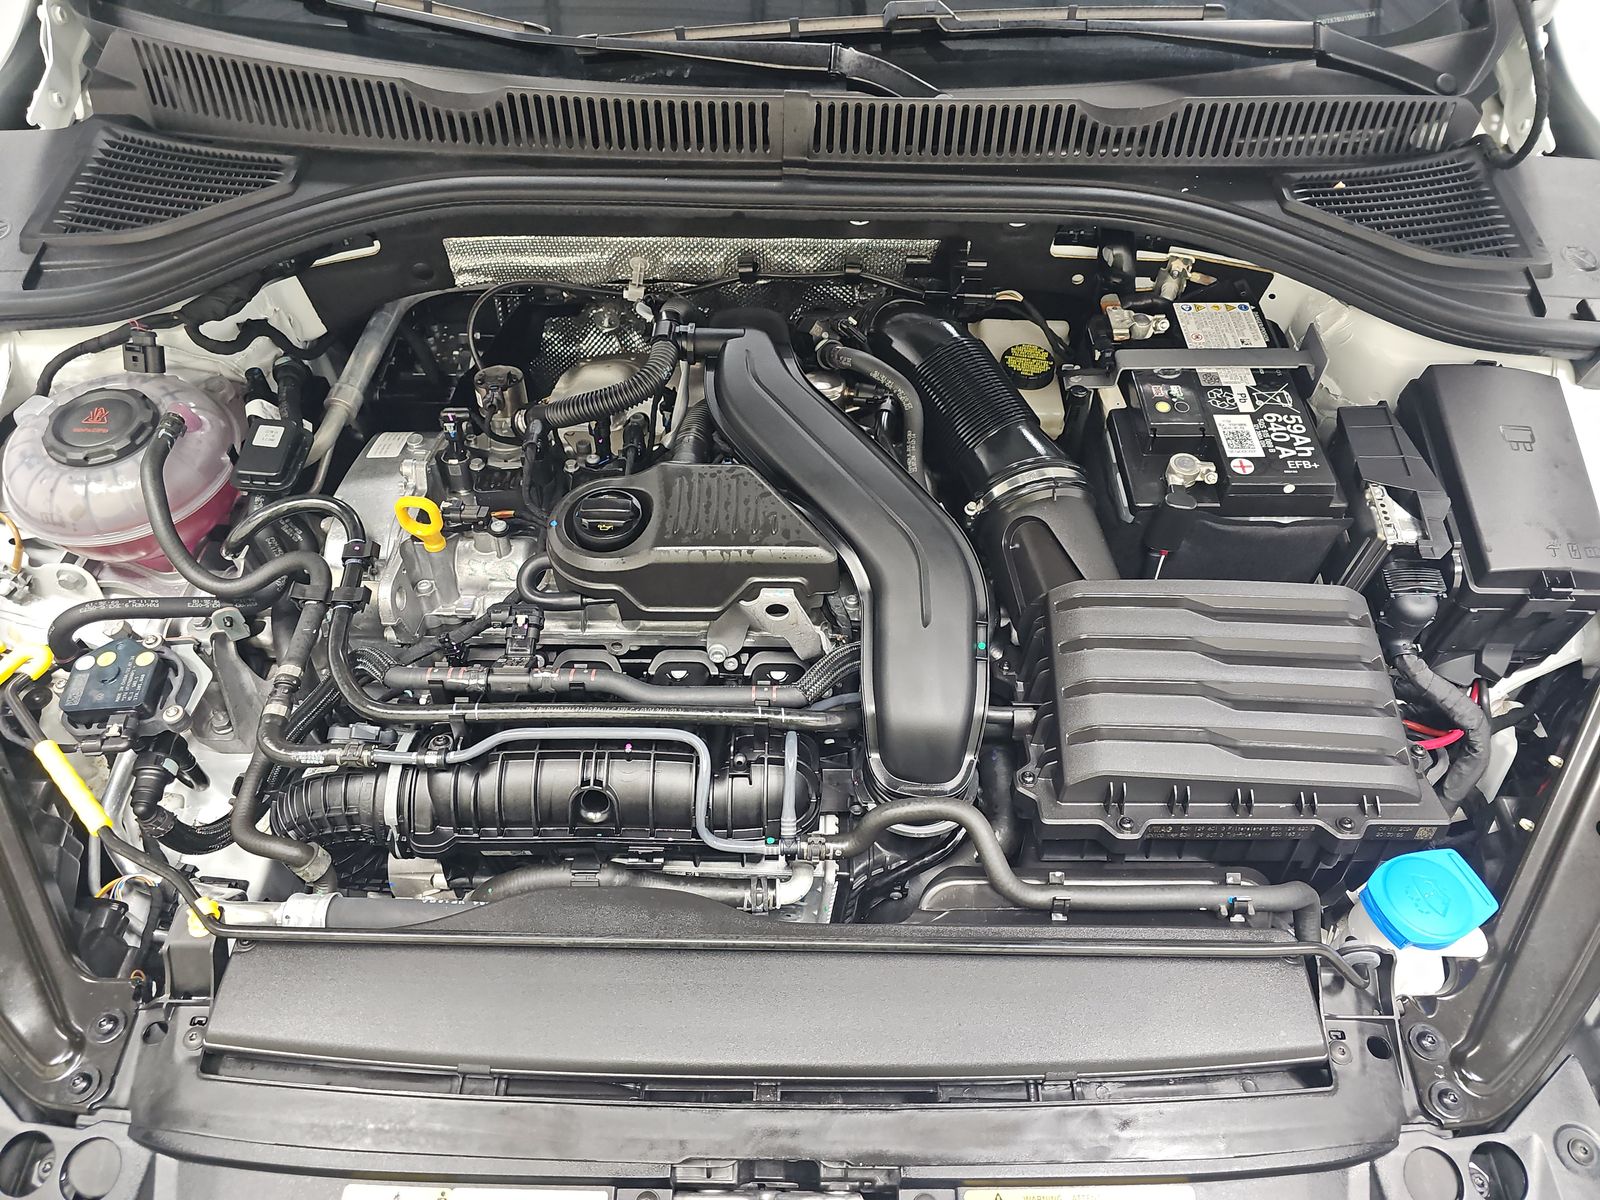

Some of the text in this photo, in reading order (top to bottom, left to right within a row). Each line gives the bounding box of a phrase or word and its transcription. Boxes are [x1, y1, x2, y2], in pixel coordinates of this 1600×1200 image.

[1263, 413, 1290, 442] 640
[1283, 414, 1315, 457] 59Ah
[1275, 446, 1297, 459] A
[1286, 460, 1320, 469] EFB+
